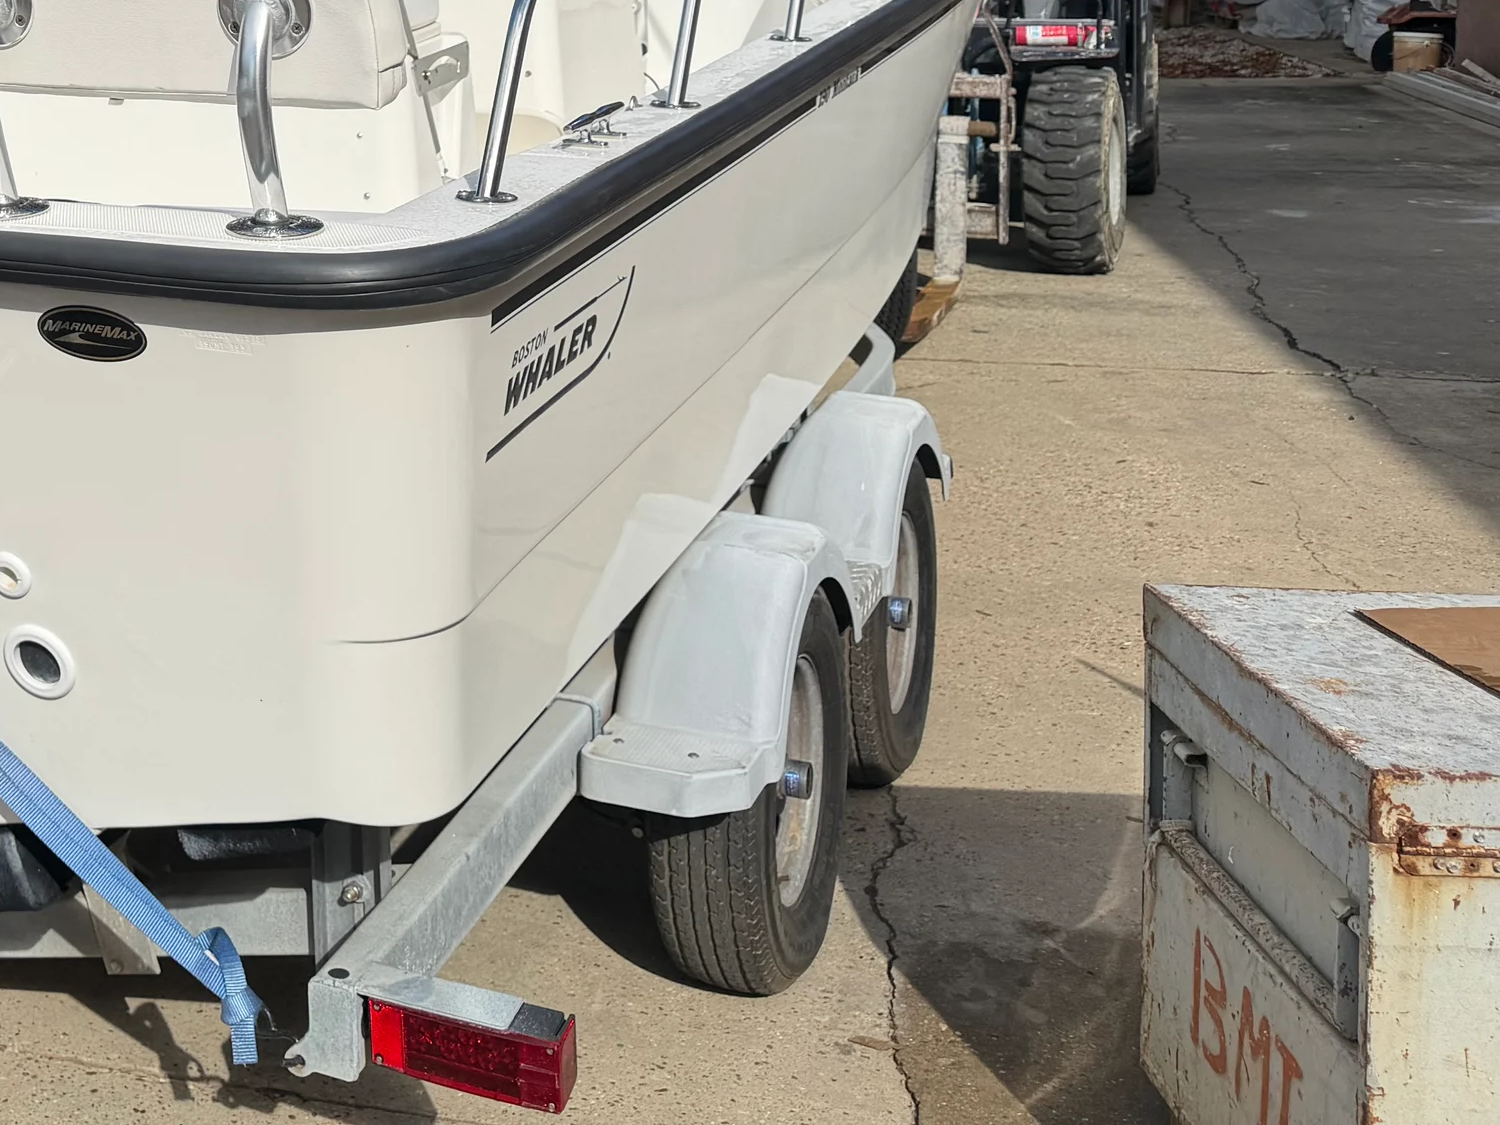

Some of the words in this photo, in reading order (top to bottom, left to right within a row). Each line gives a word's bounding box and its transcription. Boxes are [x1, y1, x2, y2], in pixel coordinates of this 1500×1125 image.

[503, 314, 598, 417] WHALER
[511, 327, 549, 369] BOSTON
[1190, 927, 1304, 1125] BMT
